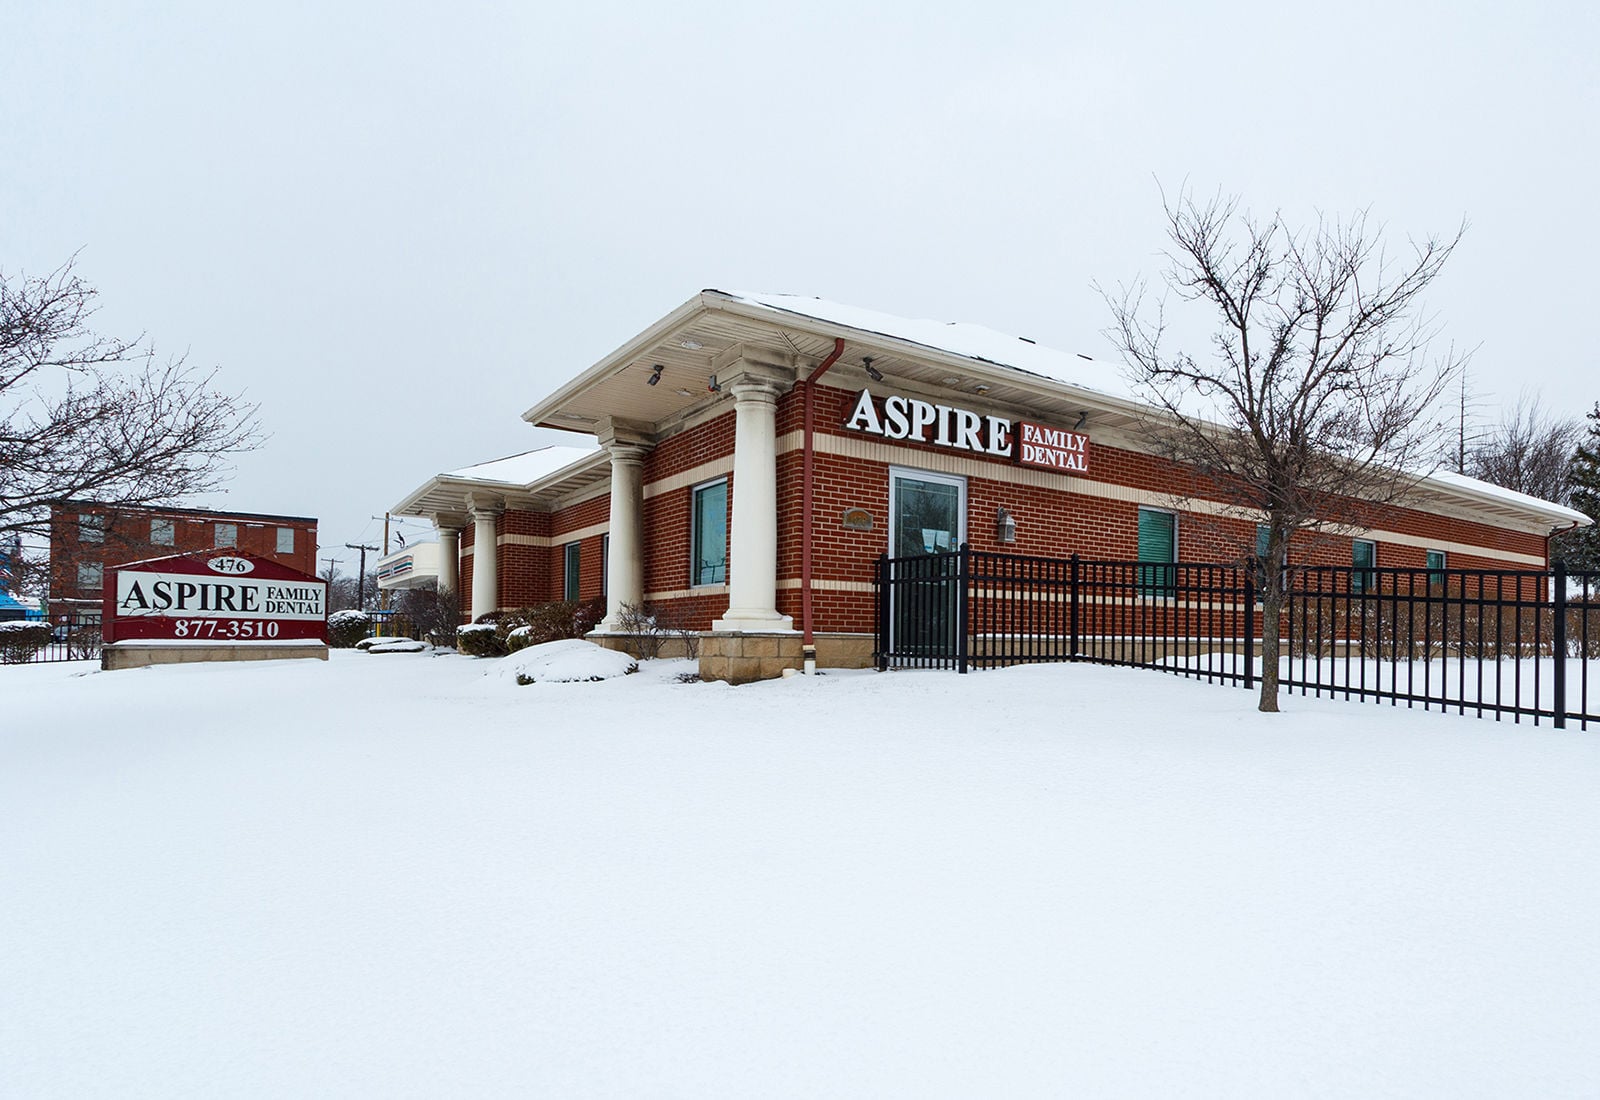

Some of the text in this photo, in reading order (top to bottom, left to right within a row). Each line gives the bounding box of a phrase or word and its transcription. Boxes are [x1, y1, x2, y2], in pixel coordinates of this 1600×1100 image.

[846, 388, 1012, 457] ASPIRE
[1022, 423, 1087, 453] FAMILY
[1022, 443, 1088, 472] DENTAL
[215, 558, 246, 573] 476
[120, 580, 260, 613] ASPIRE
[267, 586, 323, 601] FAMILY
[265, 601, 324, 615] DENTAL
[174, 619, 279, 638] 877-3510
